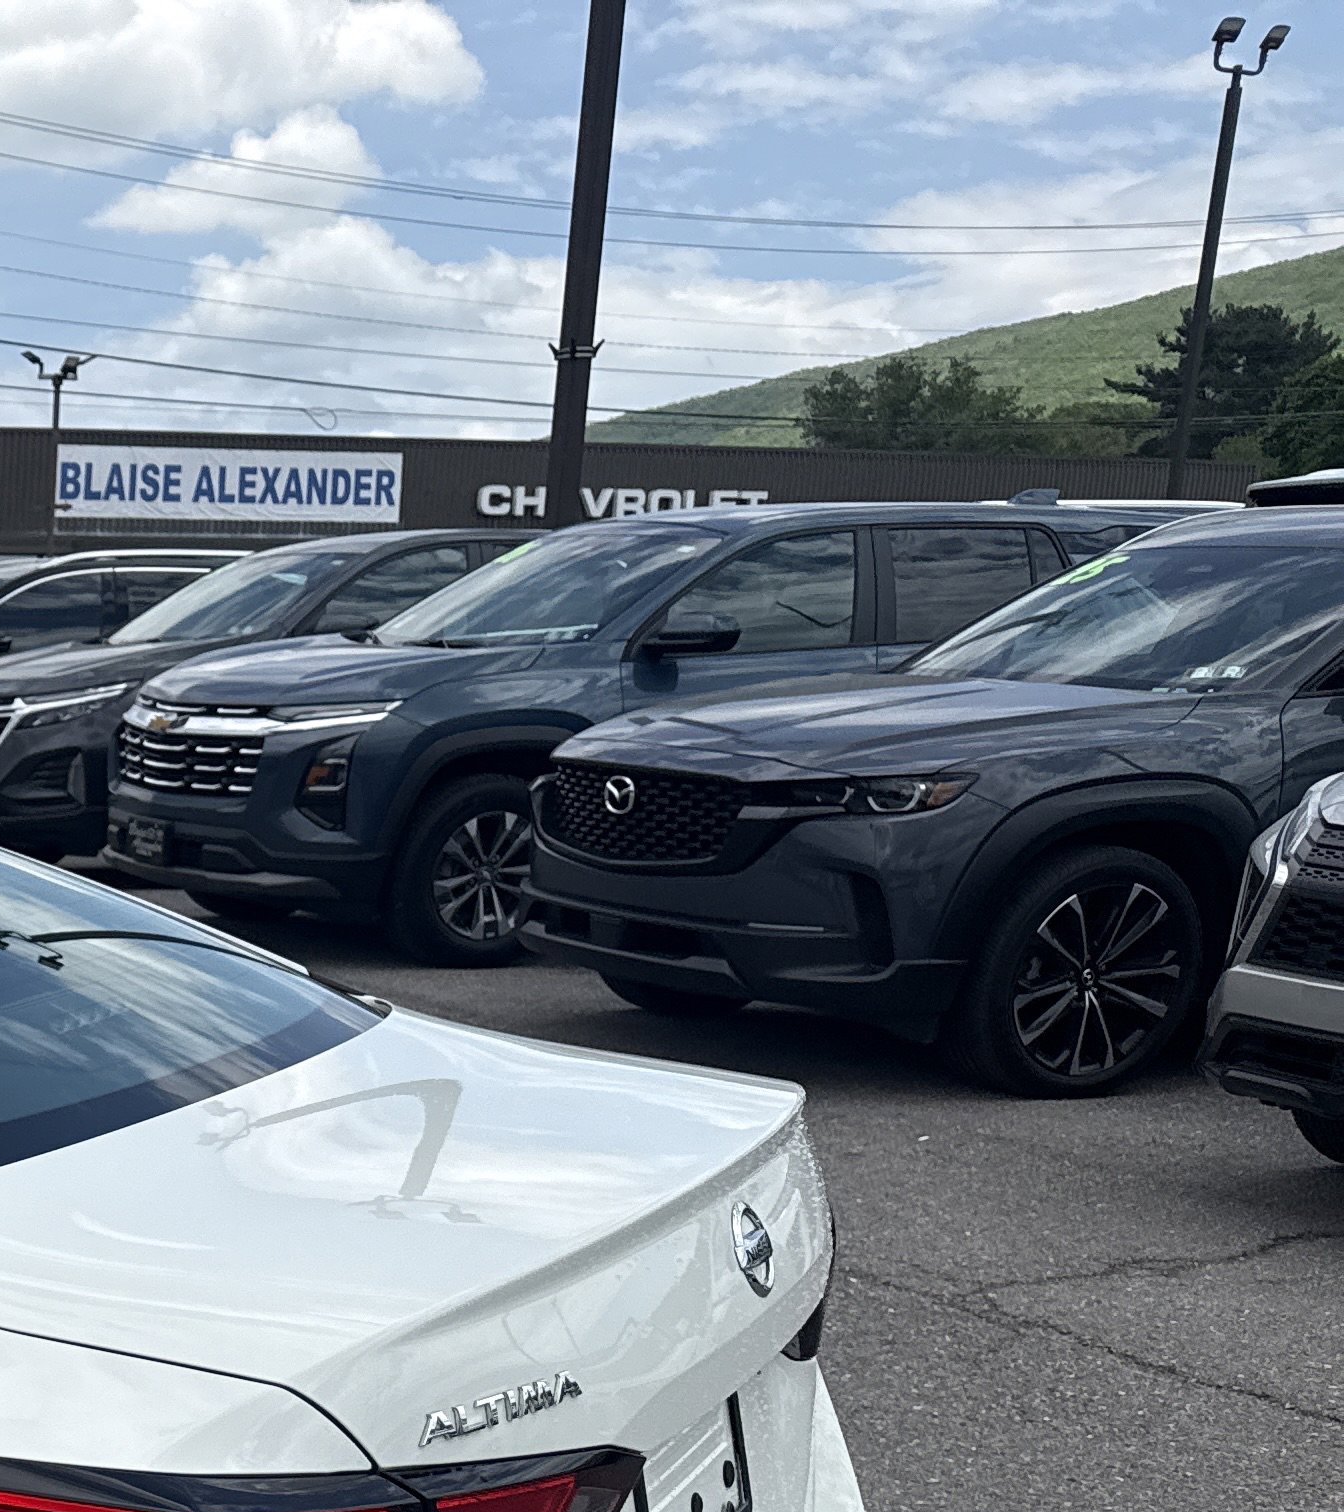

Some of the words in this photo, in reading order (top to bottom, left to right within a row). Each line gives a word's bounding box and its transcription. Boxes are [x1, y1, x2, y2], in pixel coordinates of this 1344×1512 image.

[60, 461, 183, 502] BLAISE
[192, 465, 396, 506] ALEXANDER
[418, 1370, 583, 1447] ALTIMA
